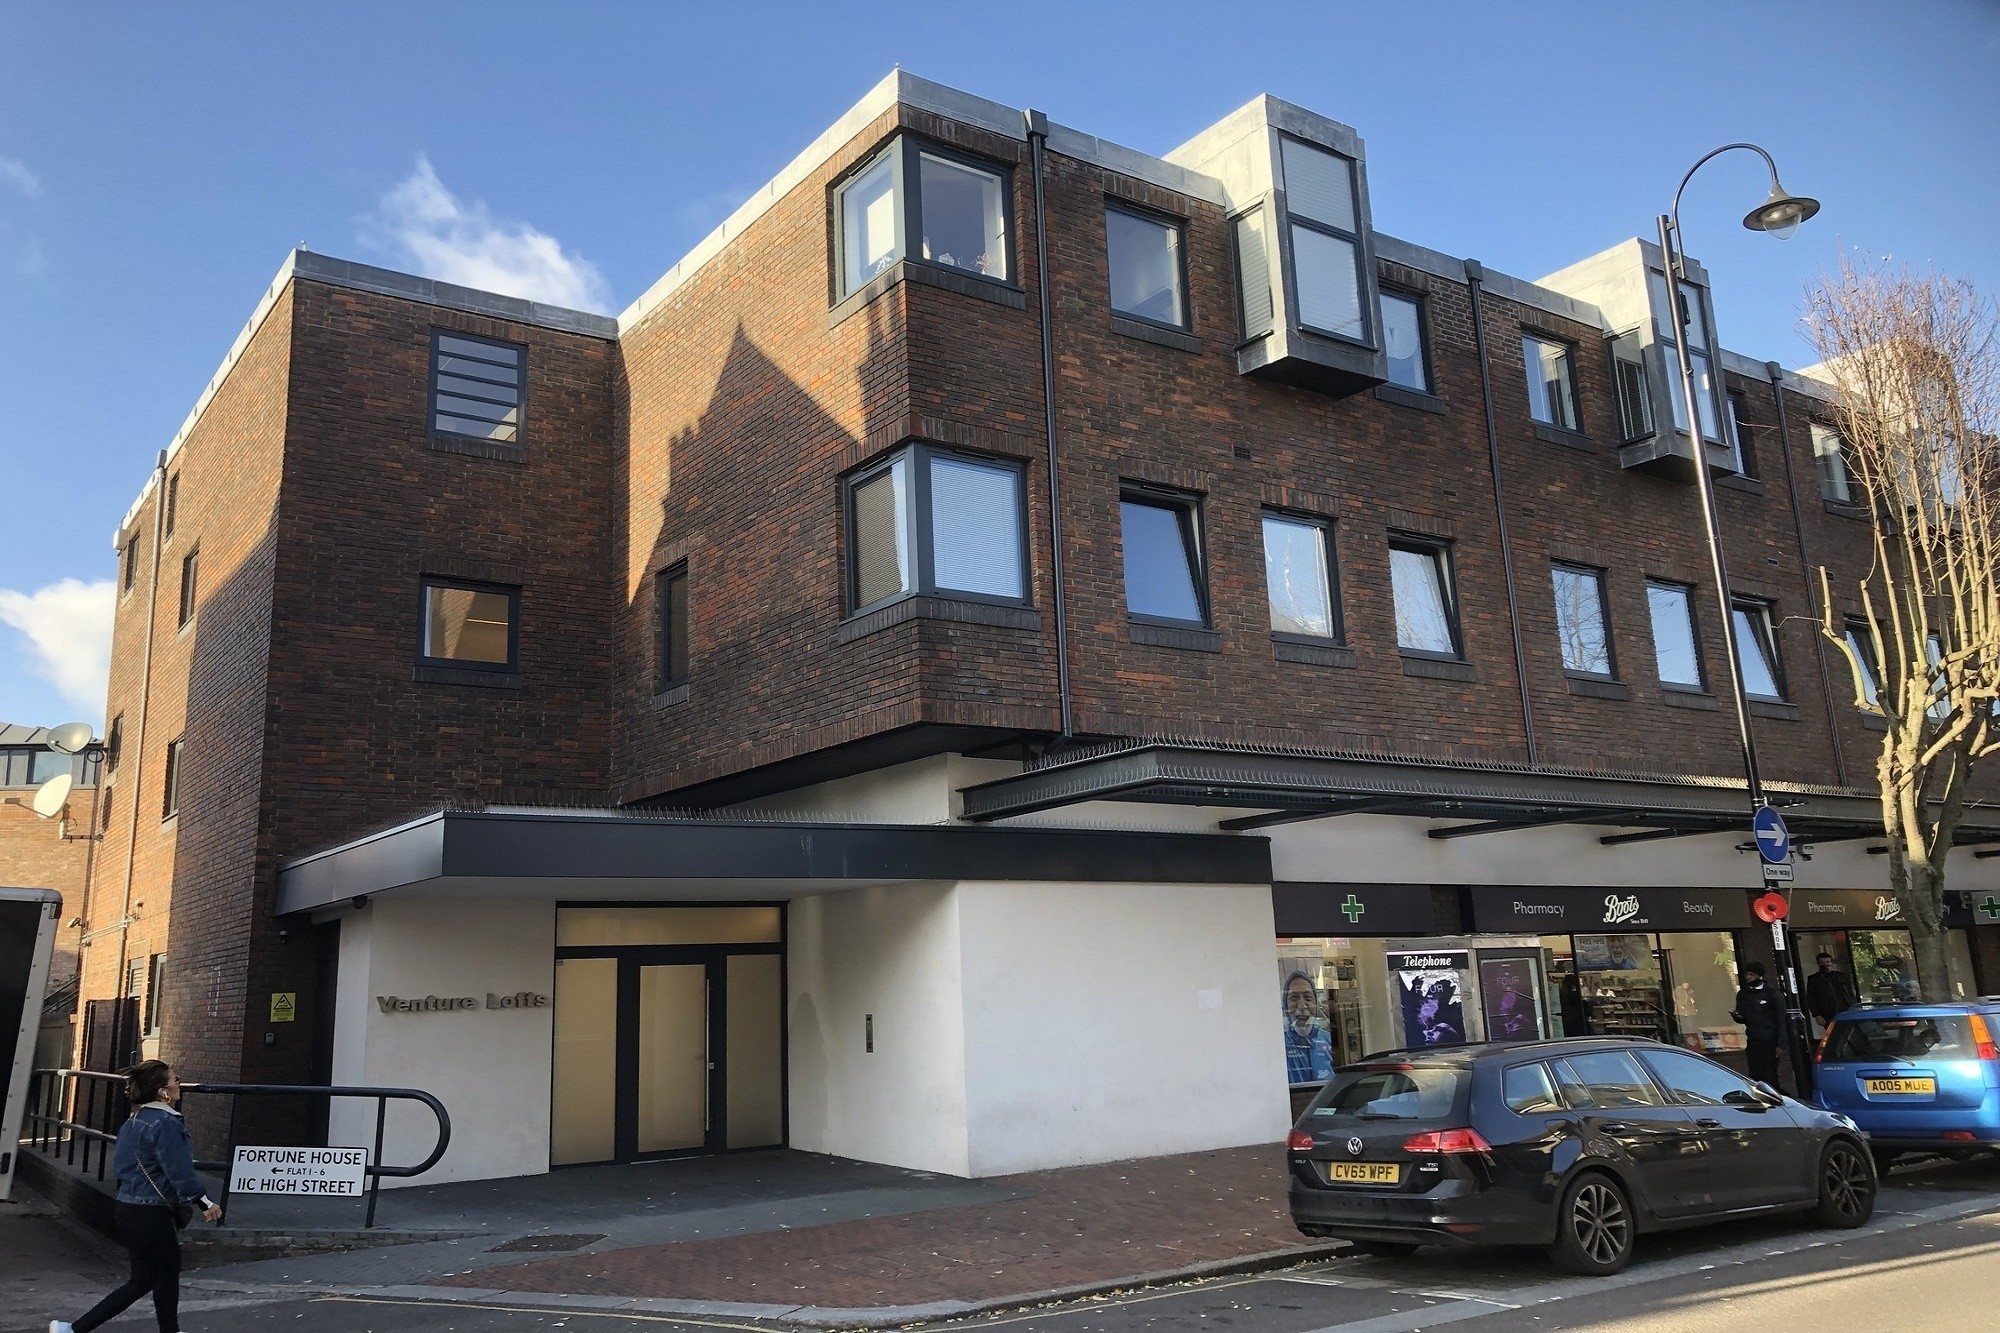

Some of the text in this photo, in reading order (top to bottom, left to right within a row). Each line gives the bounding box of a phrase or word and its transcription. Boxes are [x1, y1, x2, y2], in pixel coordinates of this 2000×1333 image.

[1766, 867, 1791, 877] One way
[1513, 901, 1565, 918] Pharmacy
[1603, 894, 1640, 923] Boots
[1683, 901, 1714, 916] Beauty
[1808, 901, 1847, 916] Pharmacy
[1875, 896, 1900, 921] Boots
[1403, 955, 1452, 969] Telephone
[376, 991, 548, 1014] Venture Lofts
[1905, 1080, 1929, 1090] MUE
[238, 1149, 362, 1165] FORTUNE HOUSE
[286, 1167, 307, 1176] FLAT
[320, 1168, 325, 1176] 6
[1335, 1164, 1394, 1180] CV65 WPF
[260, 1178, 297, 1192] HIGH
[301, 1179, 355, 1193] STREET
